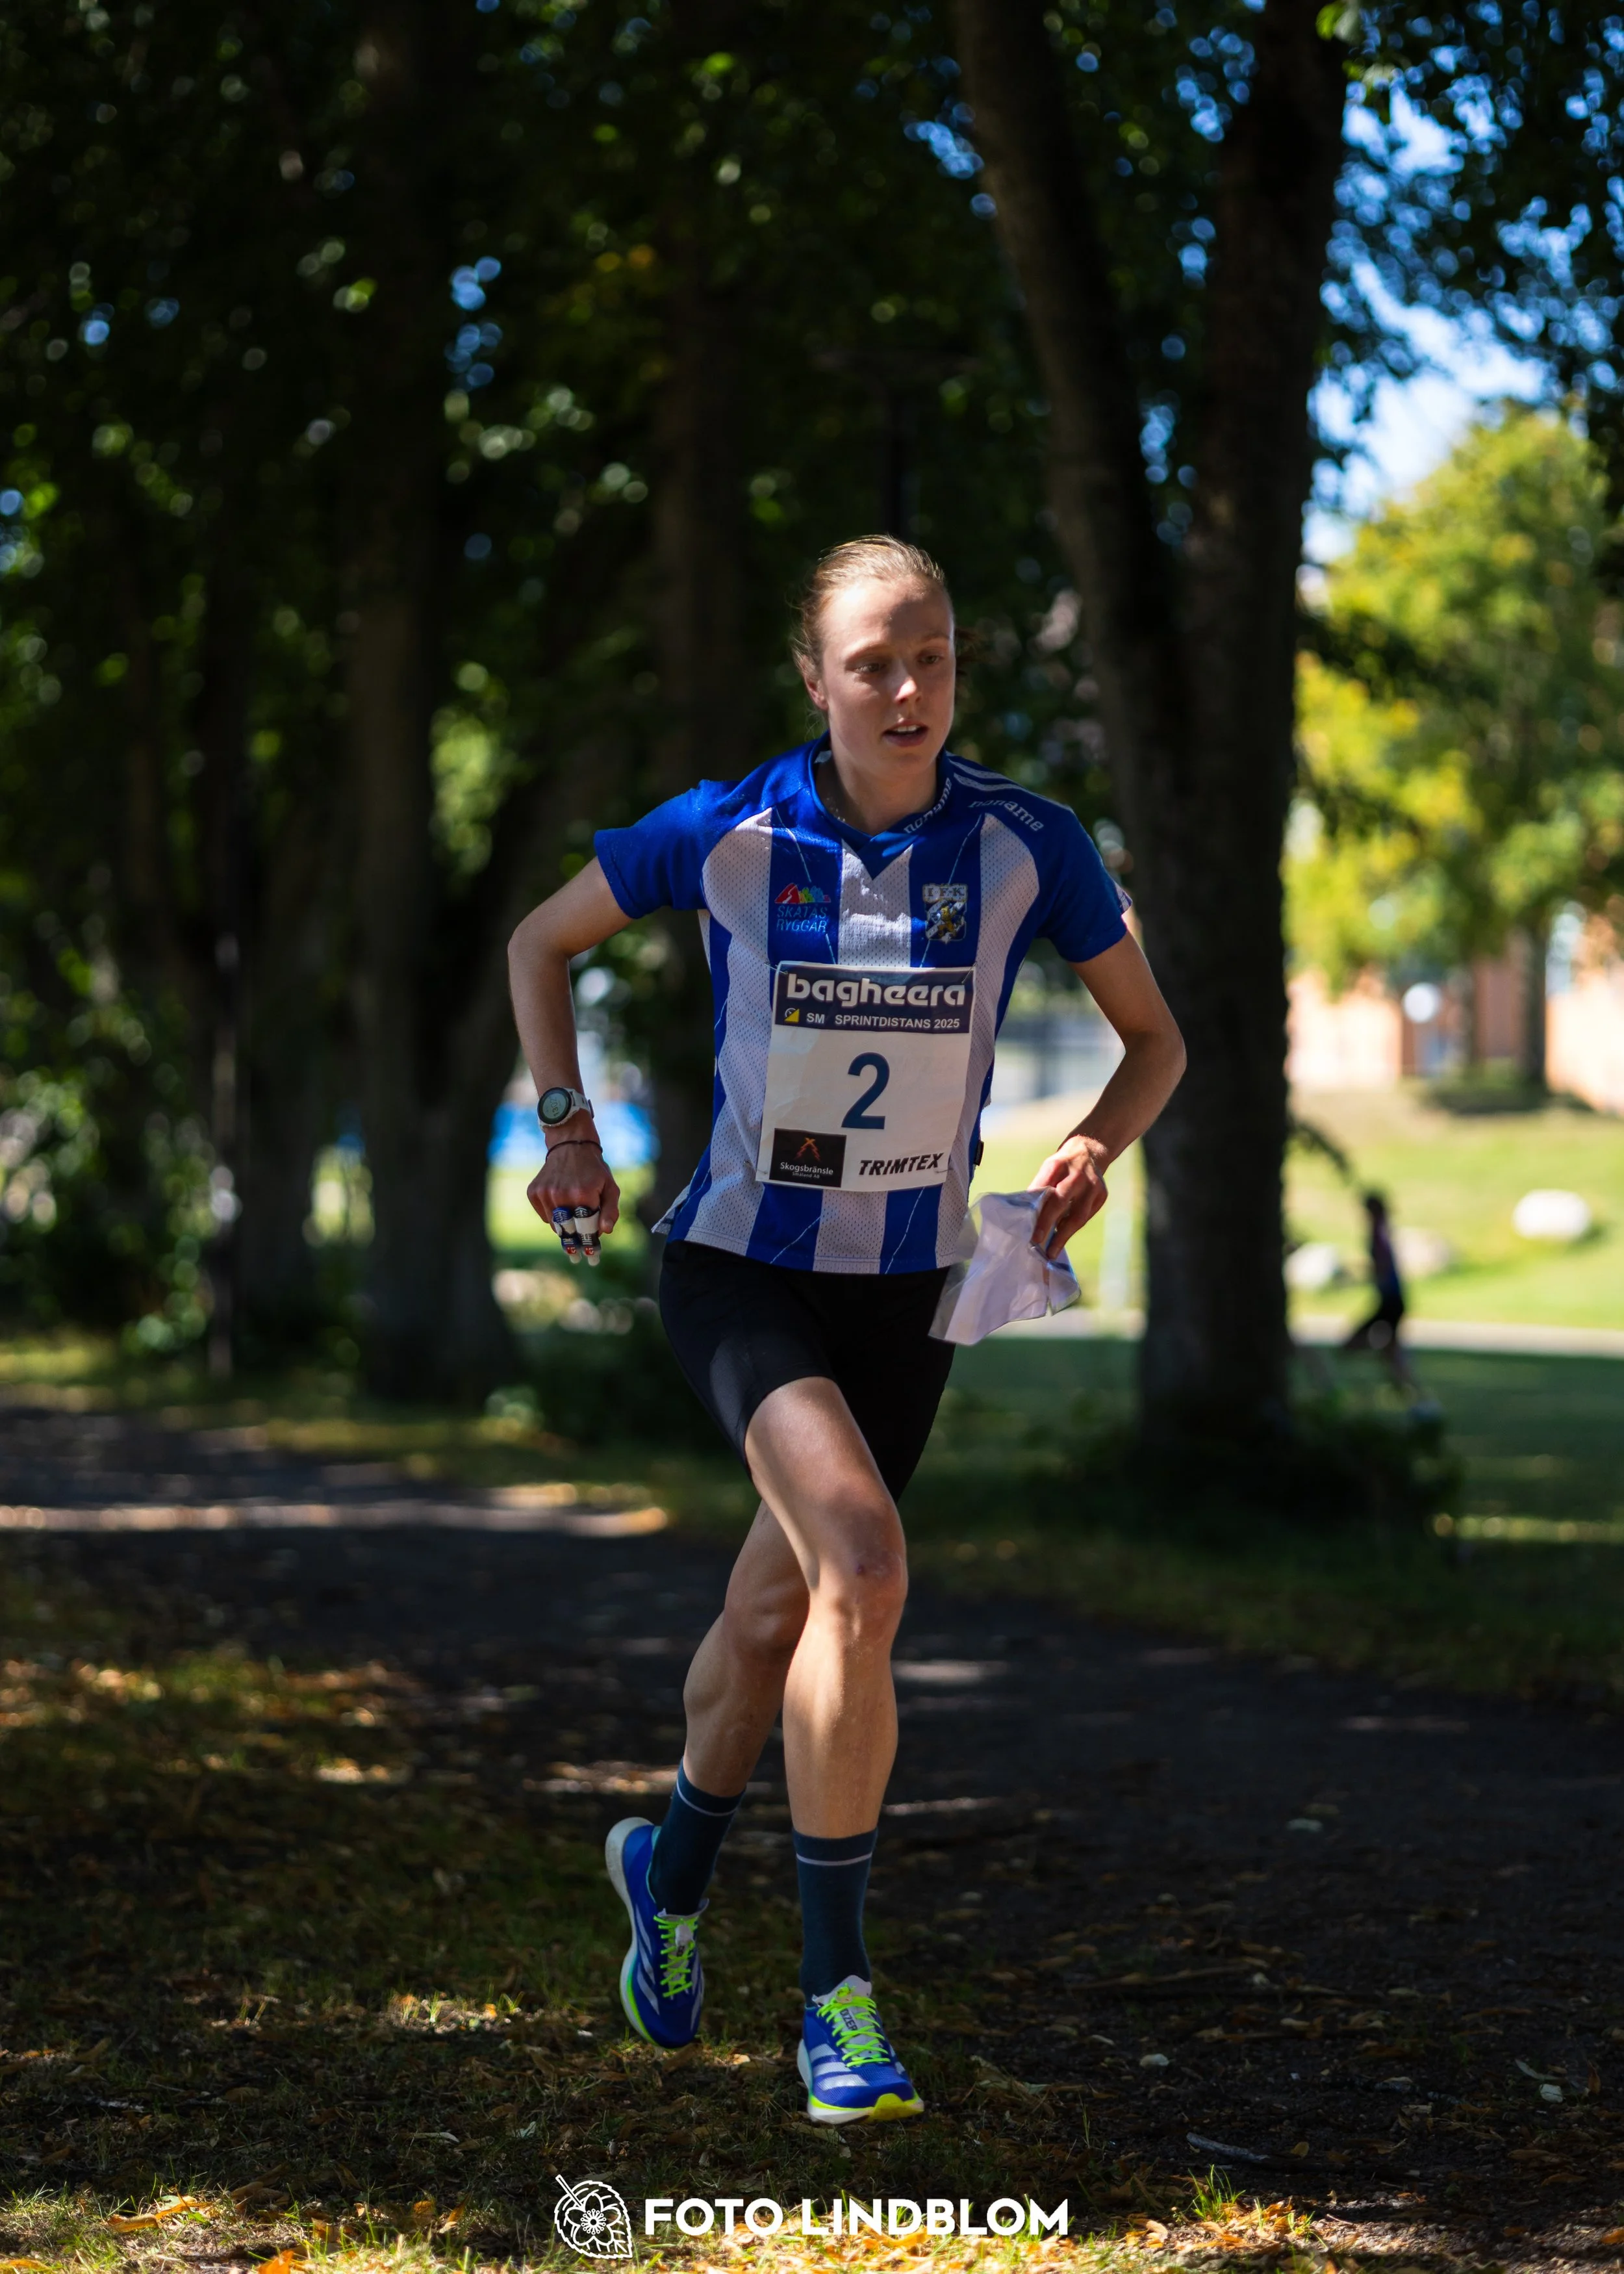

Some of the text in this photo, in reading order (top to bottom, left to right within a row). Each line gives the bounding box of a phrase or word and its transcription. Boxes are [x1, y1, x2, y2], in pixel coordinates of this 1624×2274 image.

[904, 778, 952, 834] noname
[968, 800, 1044, 832] noname
[776, 919, 827, 932] RYGGAR
[787, 973, 965, 1007] bagheera
[806, 1012, 960, 1028] SM SPRINTDISTANS 2025
[841, 1051, 890, 1130] 2
[780, 1162, 833, 1175] Skogsbränsle
[859, 1153, 944, 1175] TRIMTEX
